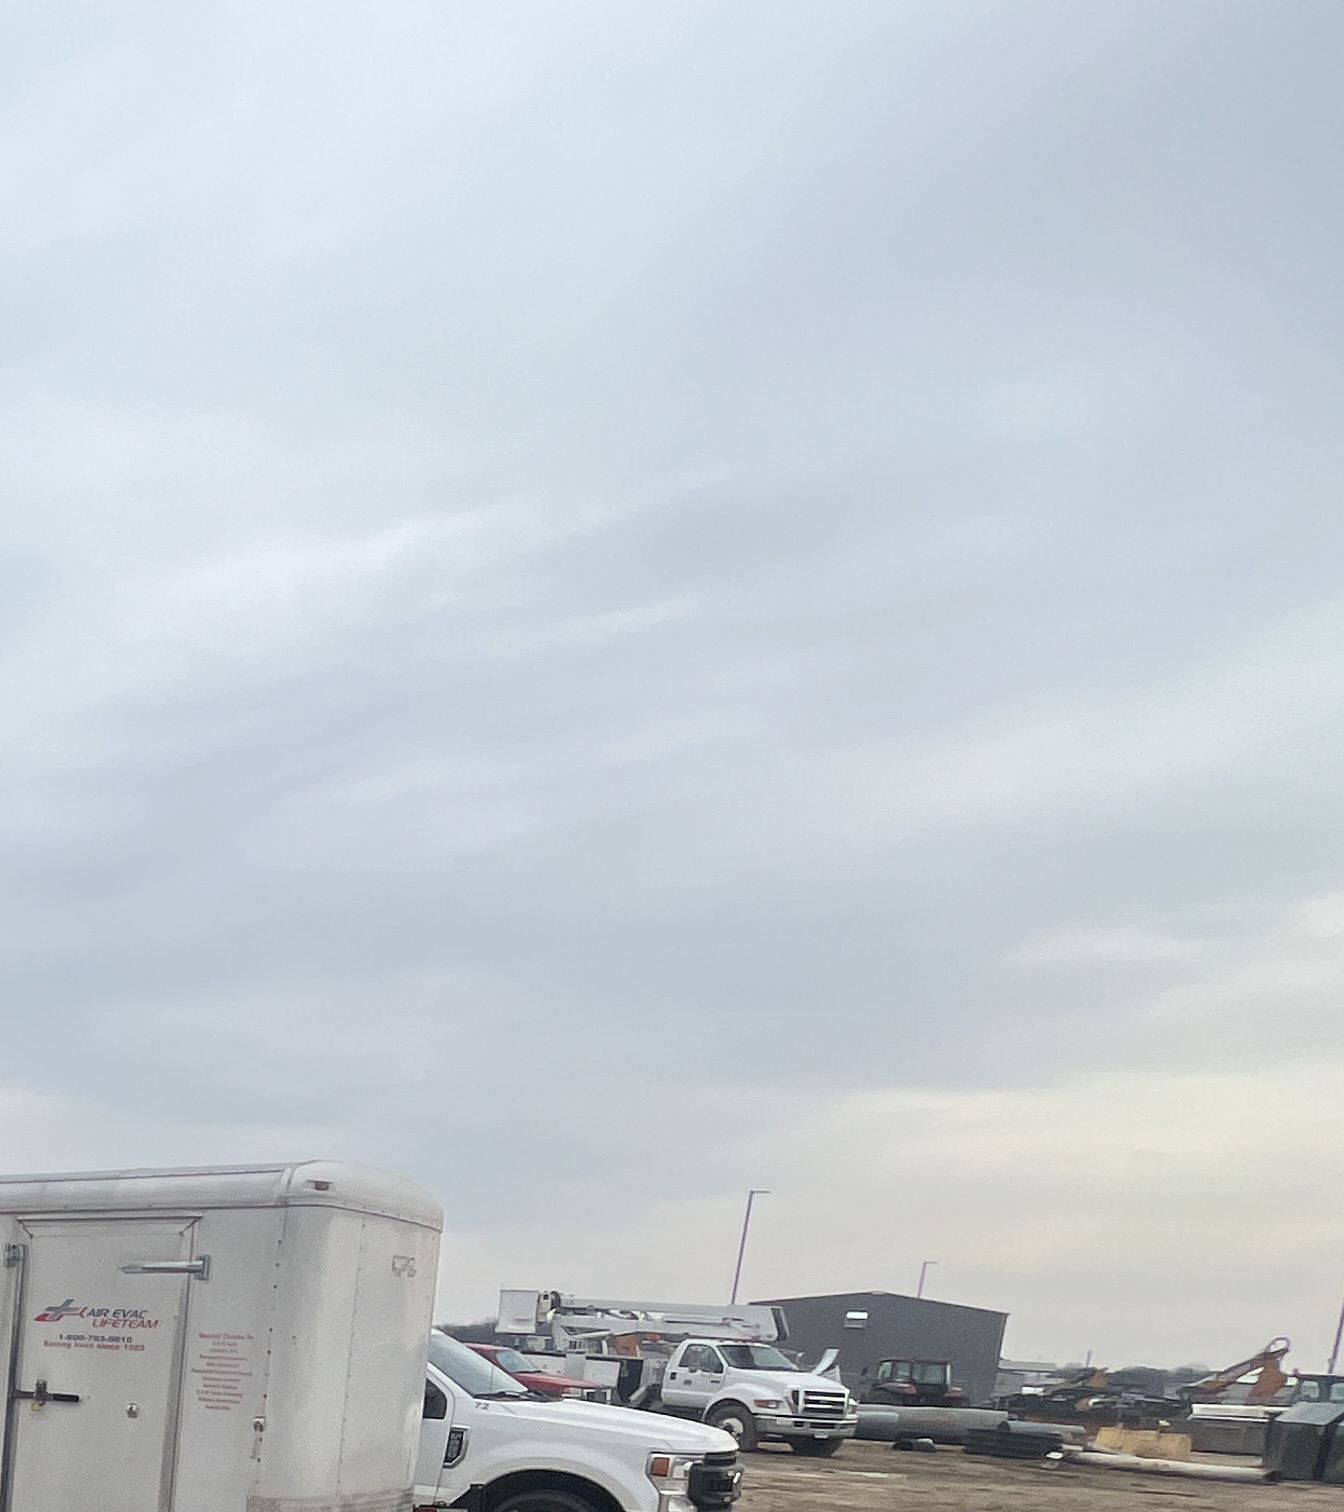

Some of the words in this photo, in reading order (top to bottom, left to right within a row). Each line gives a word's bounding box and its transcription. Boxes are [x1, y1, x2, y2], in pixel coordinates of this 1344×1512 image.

[87, 1308, 109, 1318] AIR
[113, 1309, 148, 1319] EVAC
[92, 1319, 159, 1329] LIFETEAM
